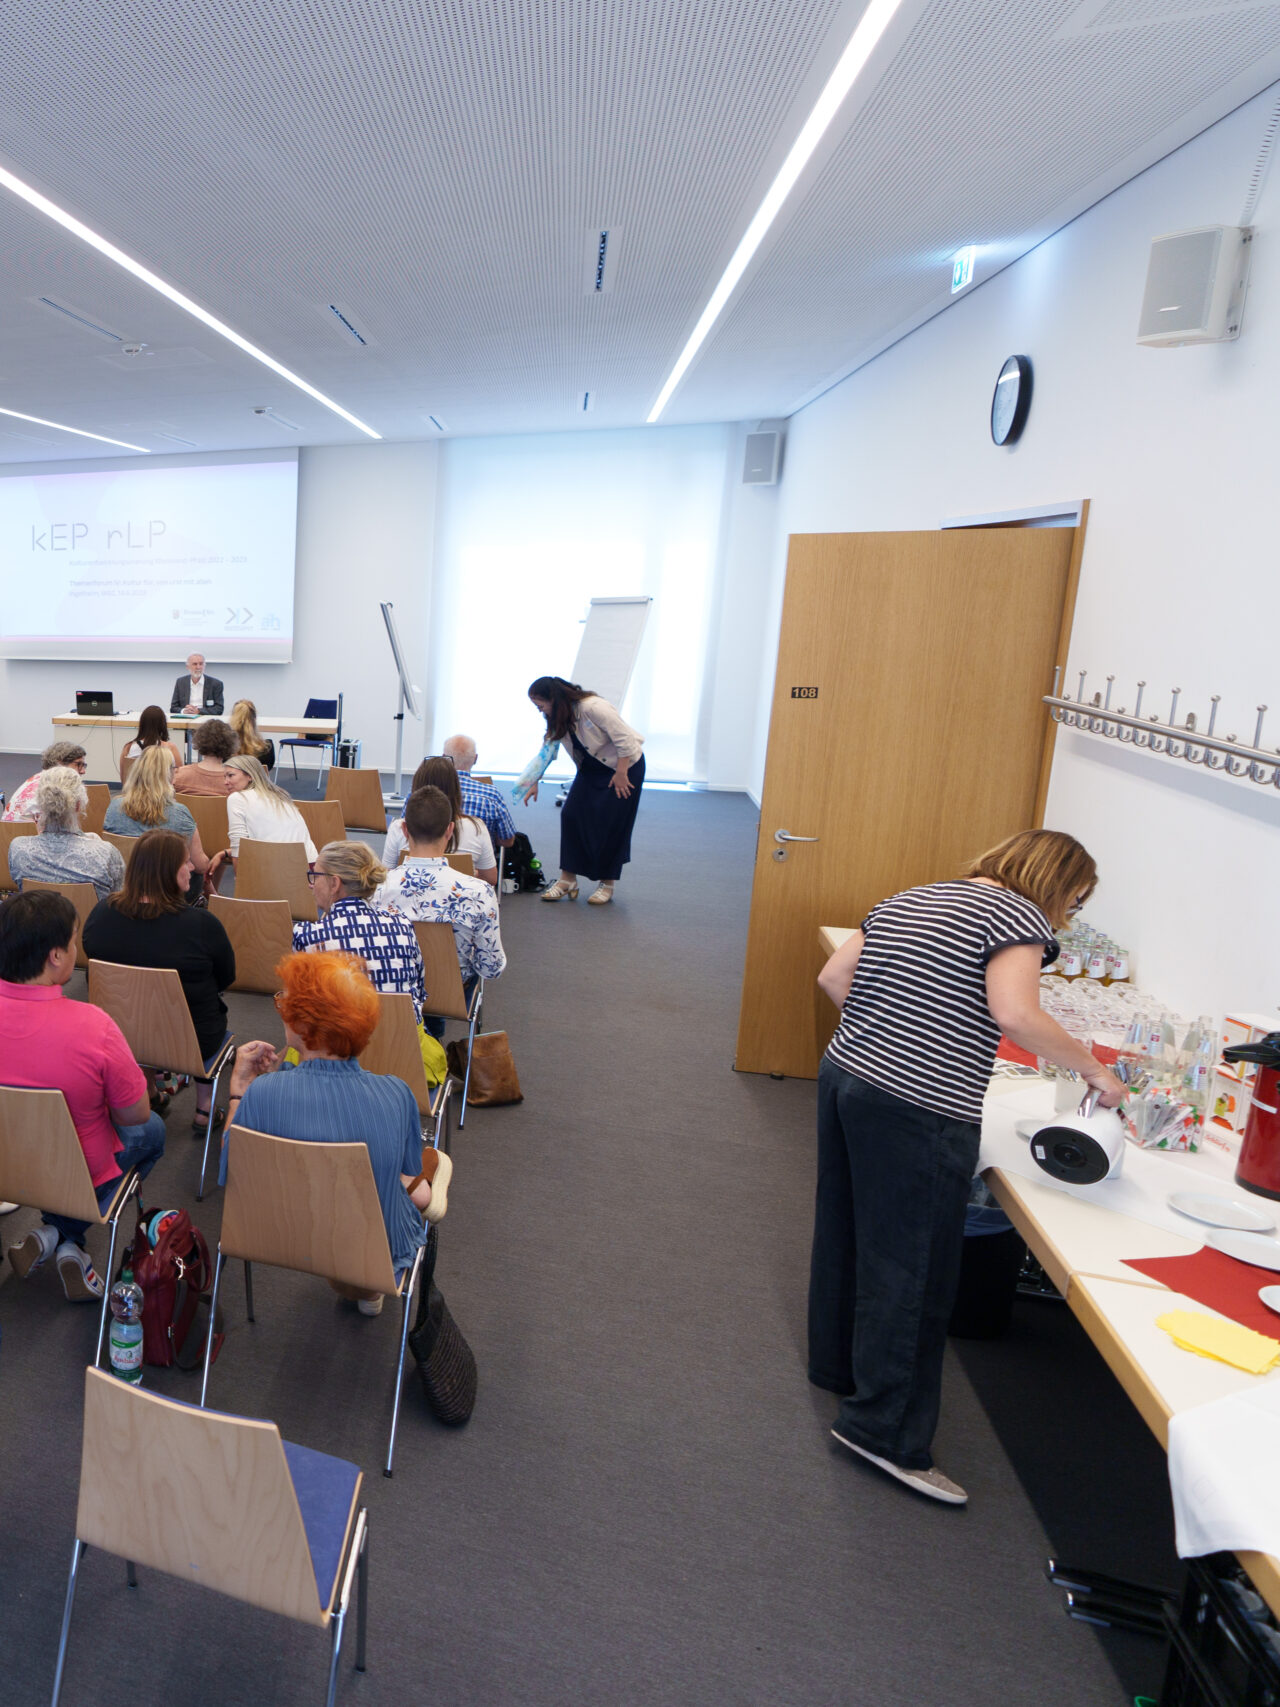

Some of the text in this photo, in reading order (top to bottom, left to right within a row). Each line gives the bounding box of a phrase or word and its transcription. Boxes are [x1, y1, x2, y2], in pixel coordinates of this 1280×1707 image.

[31, 519, 167, 552] kEP rLP
[793, 687, 817, 698] 108
